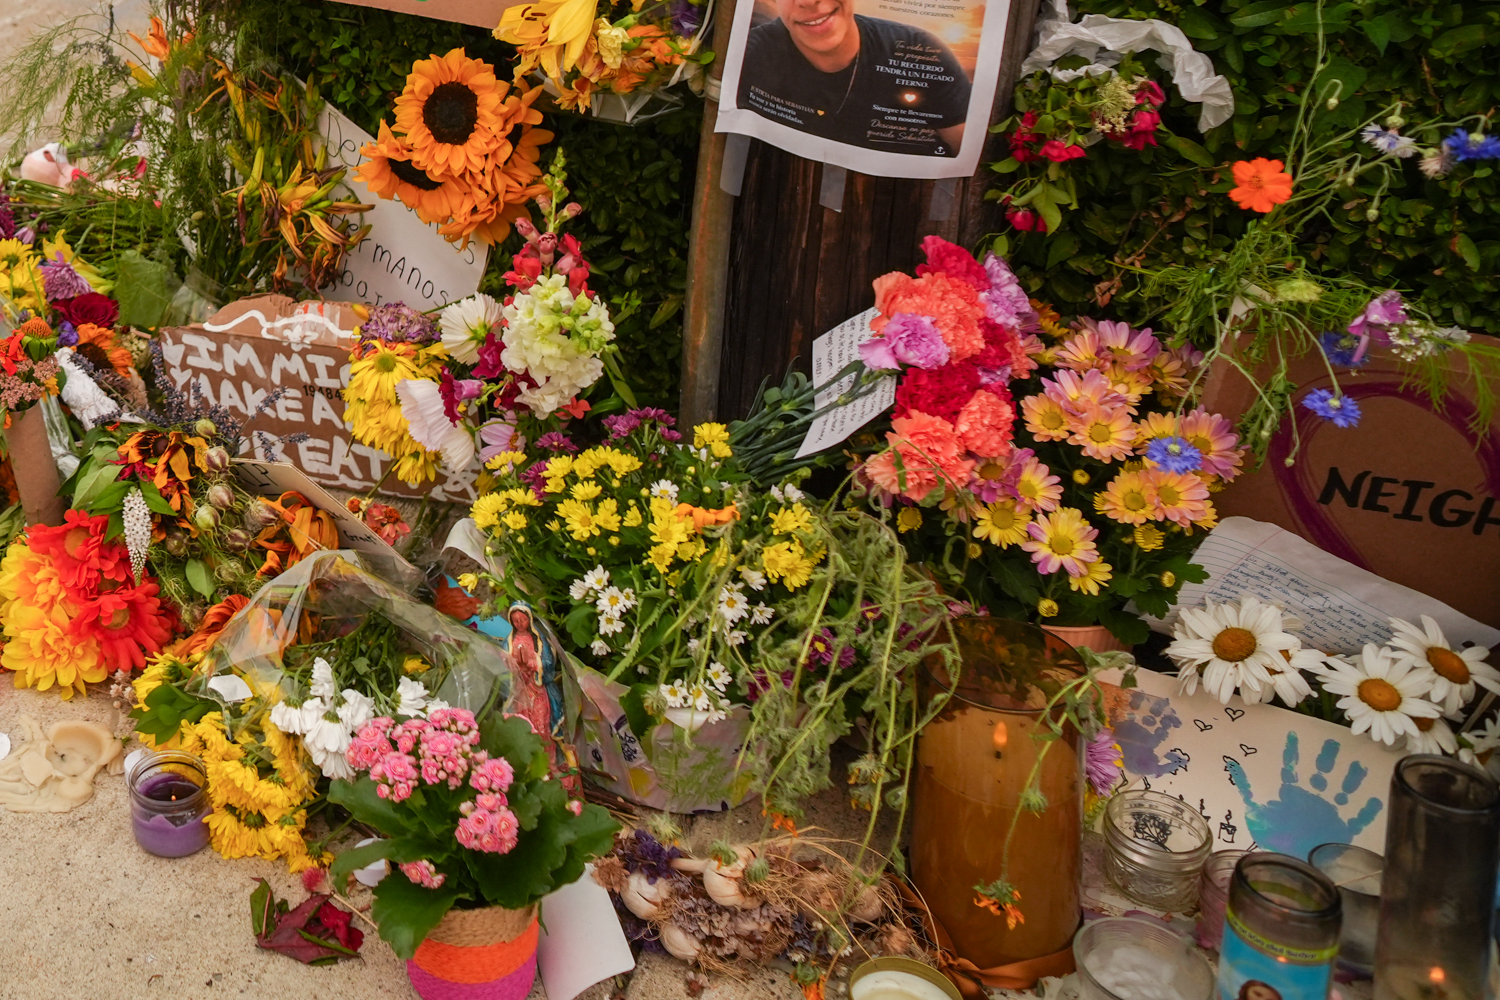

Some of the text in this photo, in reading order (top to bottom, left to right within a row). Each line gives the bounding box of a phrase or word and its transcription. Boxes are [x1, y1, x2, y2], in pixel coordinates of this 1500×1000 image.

[875, 65, 907, 76] TENDRÁ
[921, 72, 954, 82] LEGADO
[900, 61, 944, 72] RECUERDO
[872, 104, 899, 114] Siempre
[908, 110, 943, 119] llevaremos
